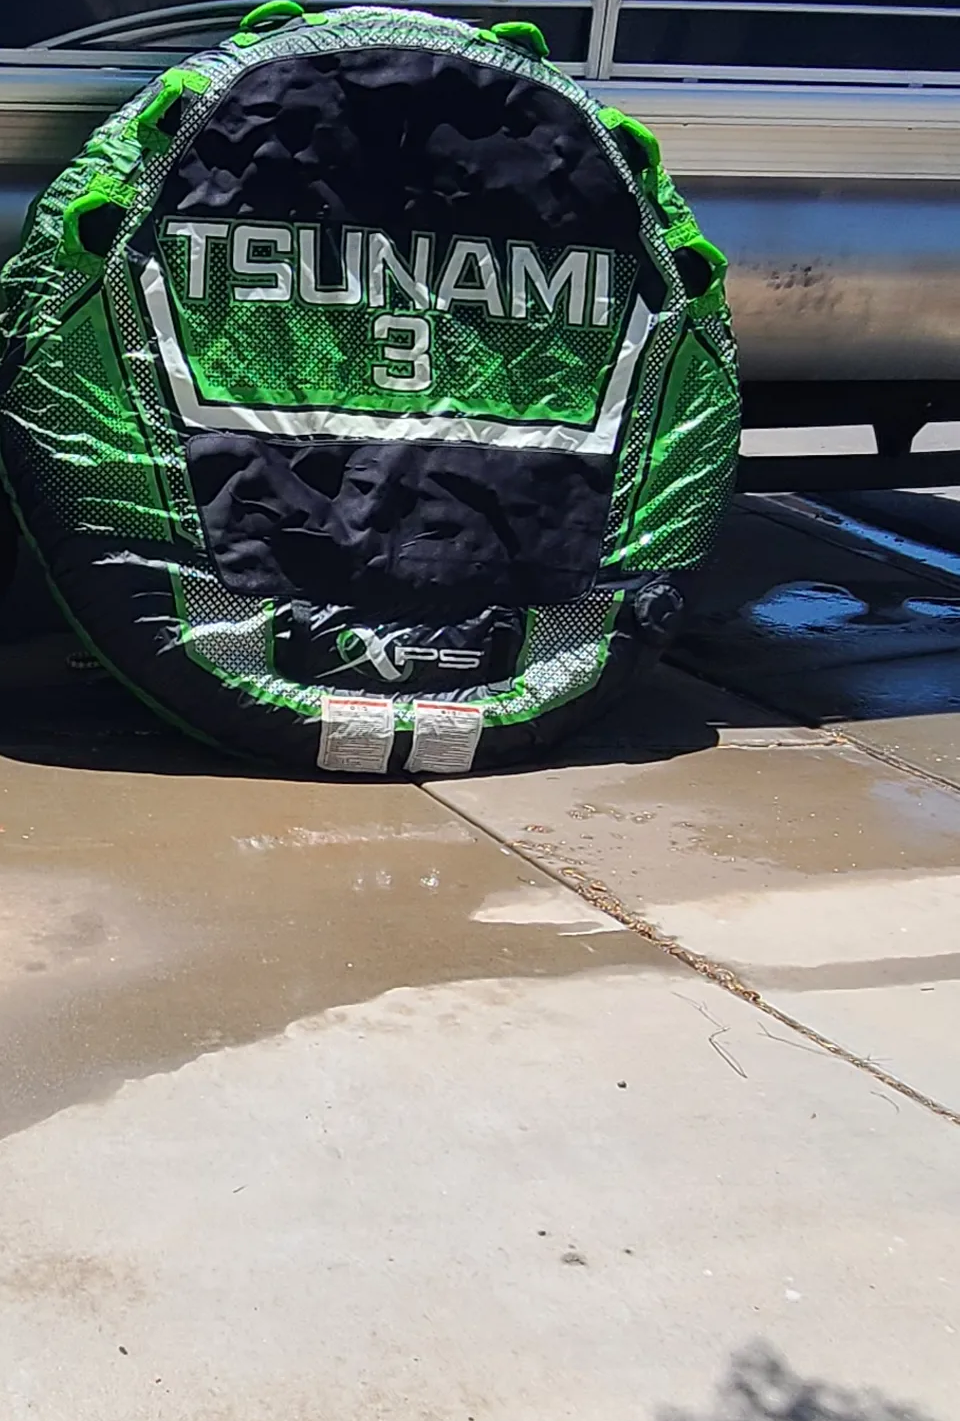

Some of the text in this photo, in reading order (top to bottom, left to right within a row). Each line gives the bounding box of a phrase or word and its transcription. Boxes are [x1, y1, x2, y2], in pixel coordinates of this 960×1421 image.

[164, 220, 613, 327] TSUNAMI
[373, 313, 431, 391] 3
[314, 627, 483, 681] XPS
